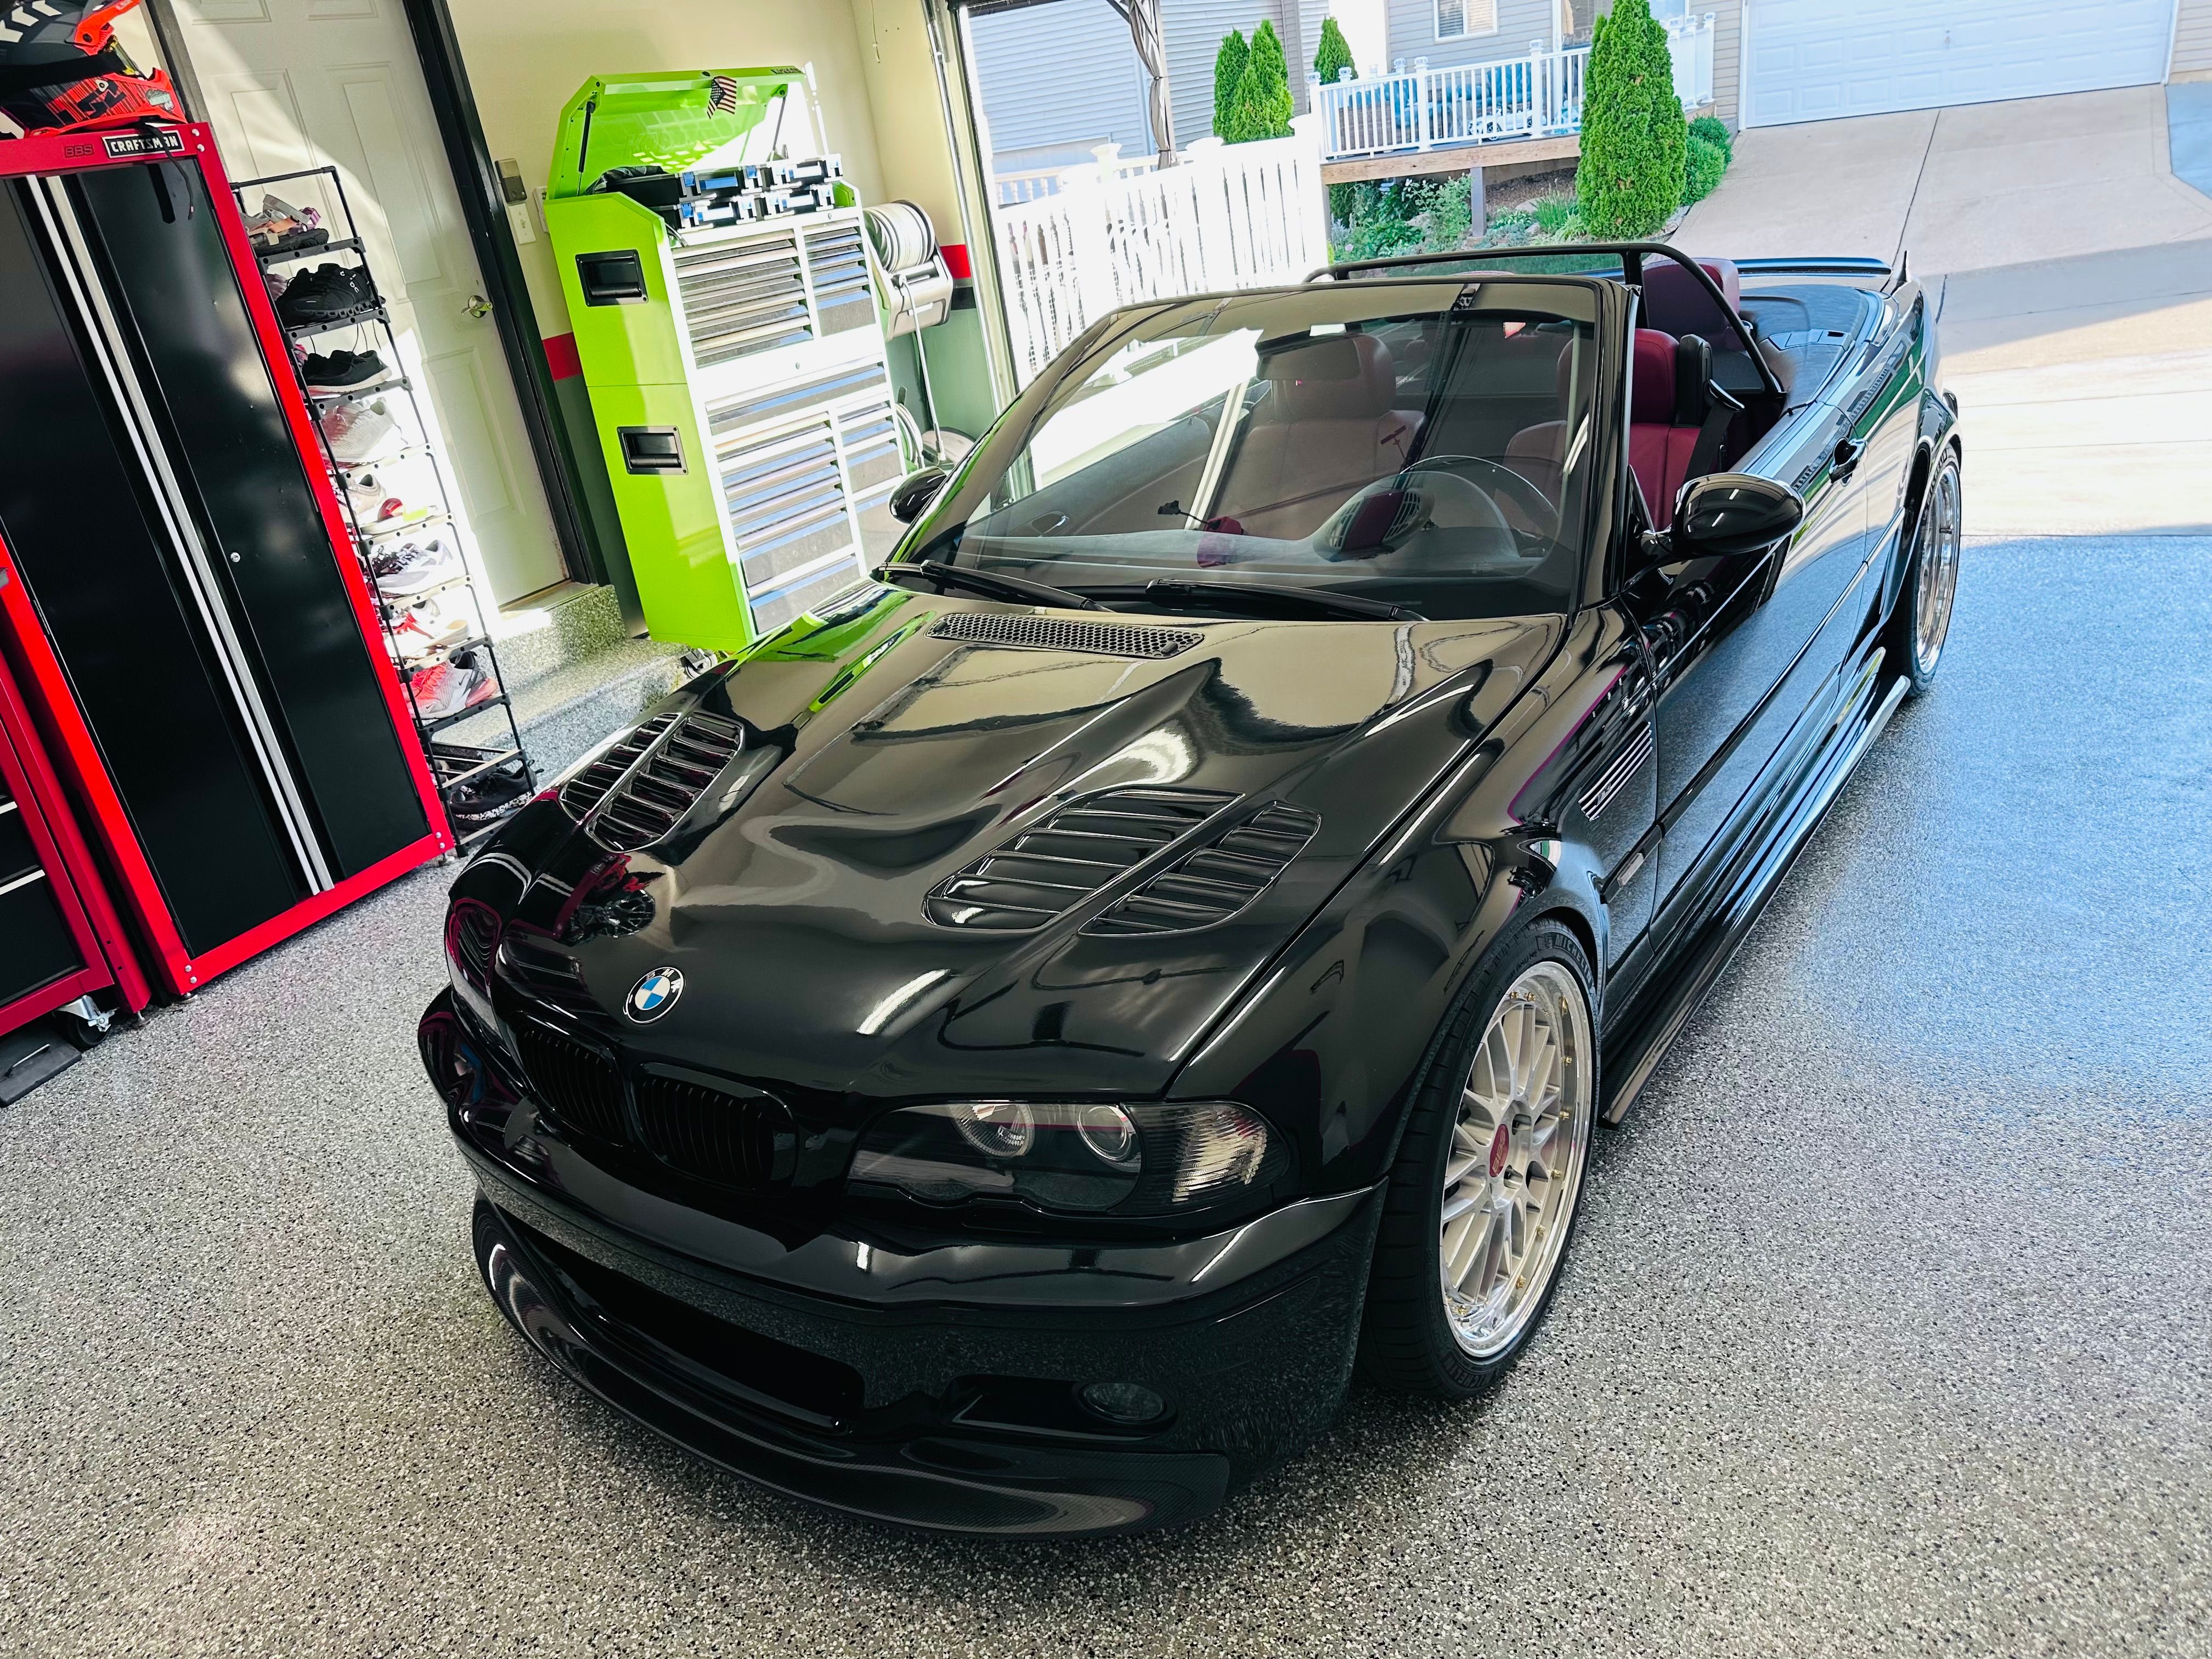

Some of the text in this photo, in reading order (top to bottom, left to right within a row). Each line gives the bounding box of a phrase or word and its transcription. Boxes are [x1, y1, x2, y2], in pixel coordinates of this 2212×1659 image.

[65, 145, 94, 159] BBS
[1555, 934, 1593, 986] MICHELIN
[1492, 1130, 1505, 1173] BBS
[1443, 1356, 1493, 1387] MICHELIN
